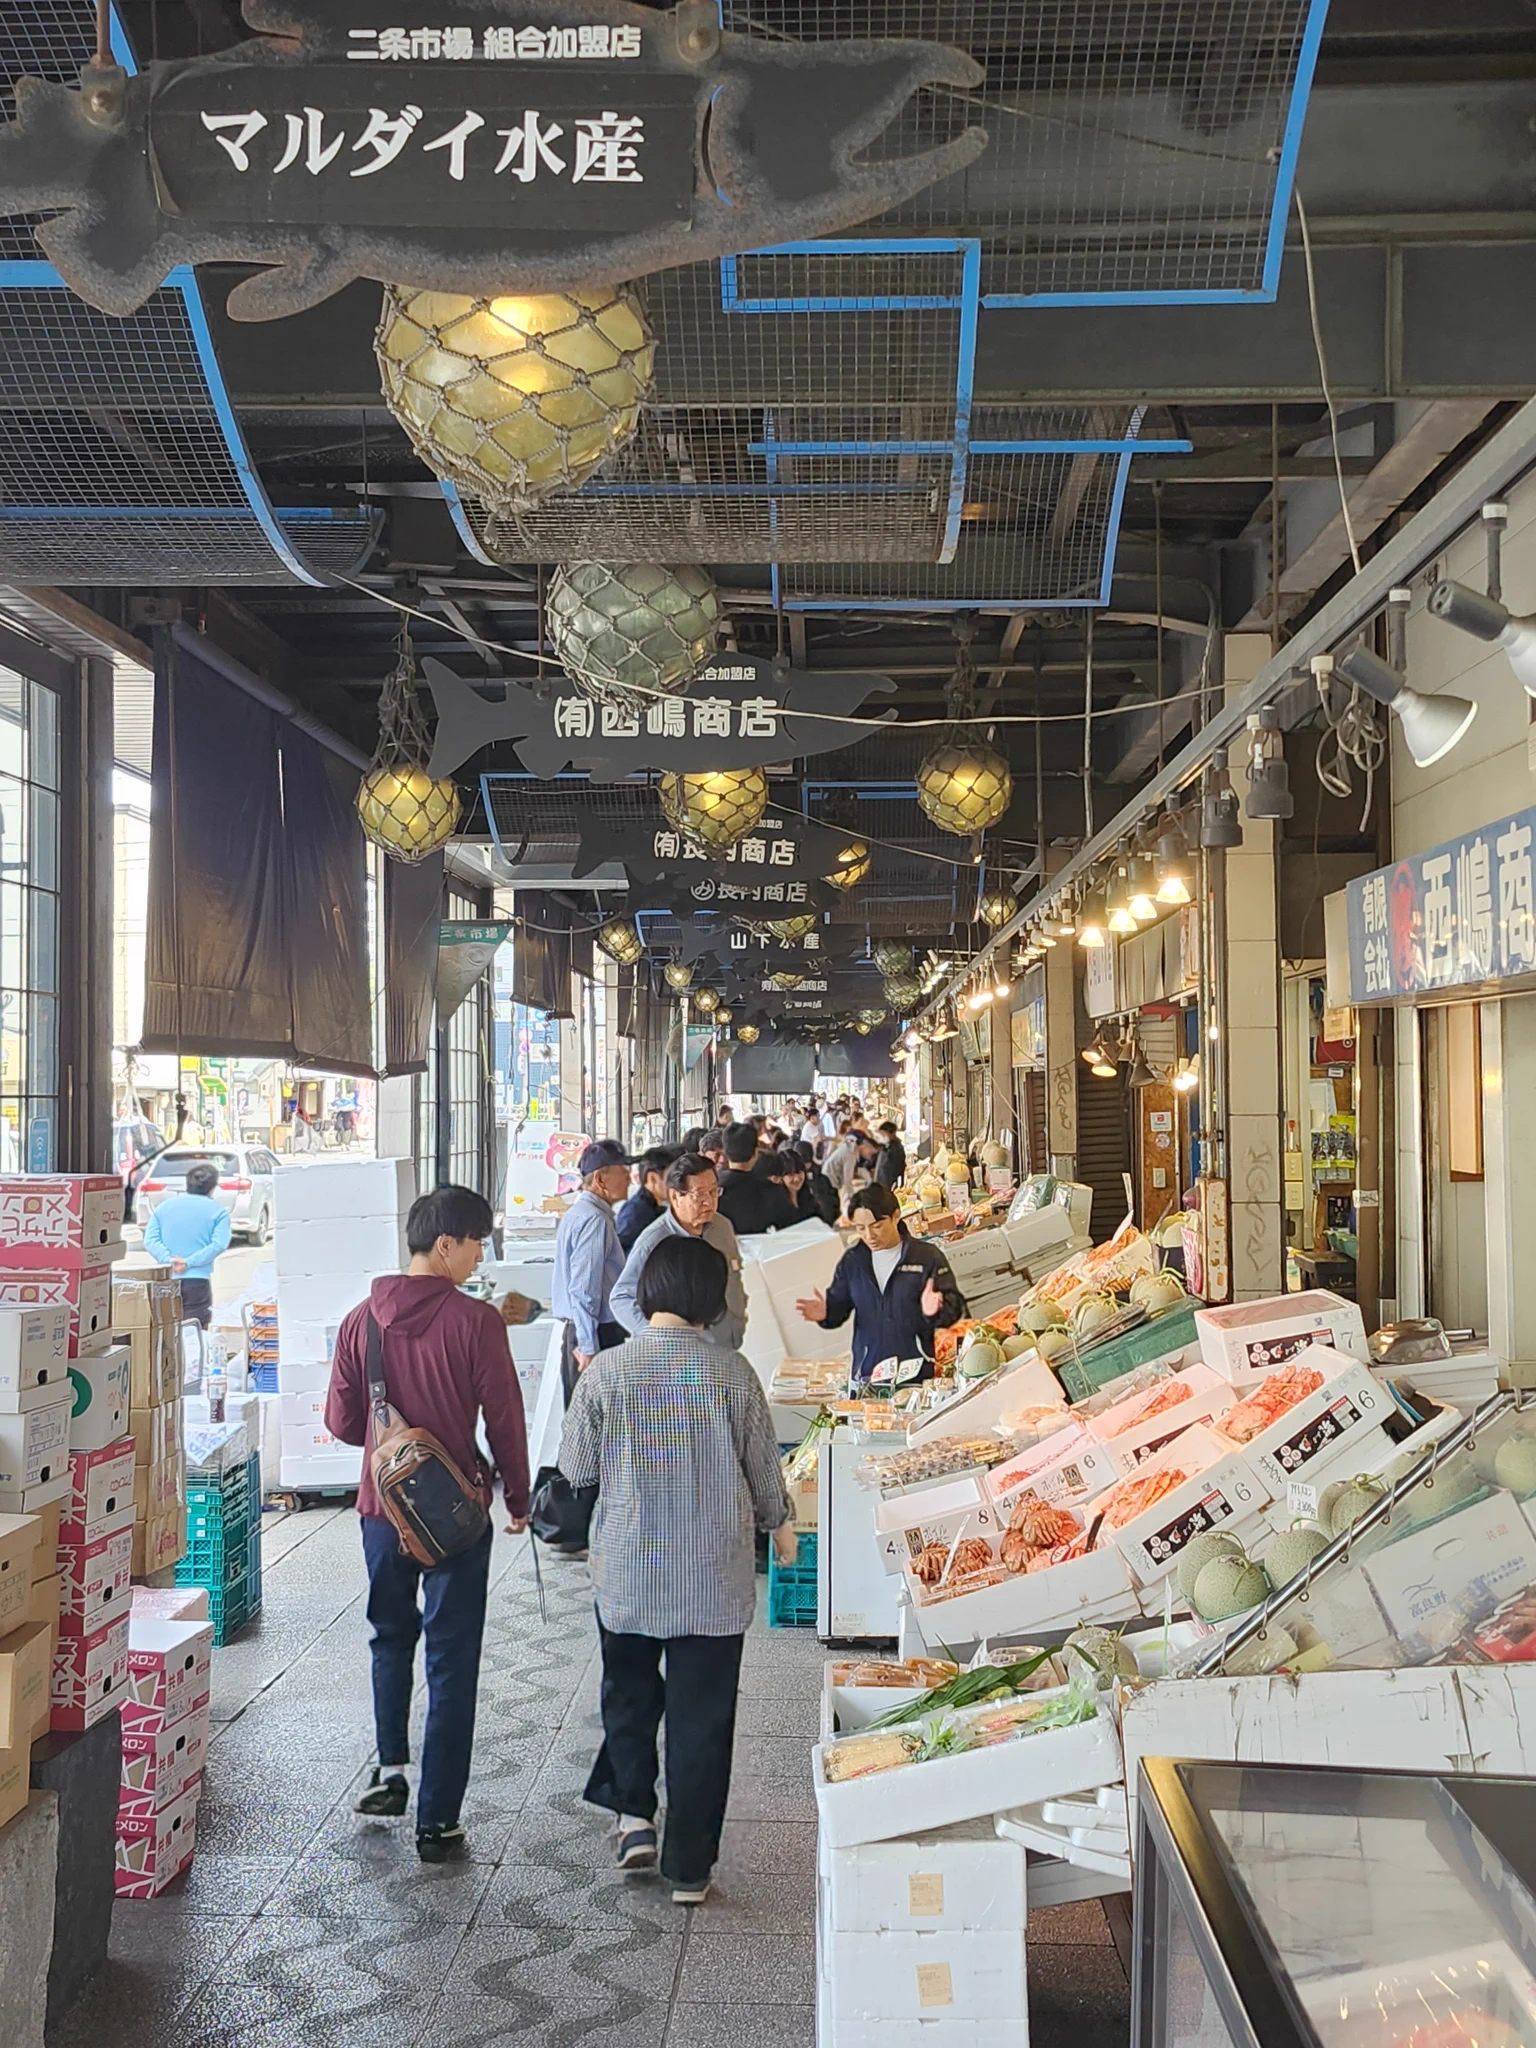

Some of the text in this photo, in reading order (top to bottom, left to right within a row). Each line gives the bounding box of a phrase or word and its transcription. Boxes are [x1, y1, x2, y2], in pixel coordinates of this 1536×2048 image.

[347, 26, 642, 60] 二条市場 組合加盟店
[200, 104, 646, 185] マルダイ水産
[2, 1195, 65, 1217] メロン
[1, 1216, 64, 1237] アサヒ
[1340, 1330, 1354, 1350] 7
[1357, 1389, 1376, 1410] 6
[1083, 1453, 1096, 1469] 6
[1233, 1482, 1252, 1502] 6
[977, 1509, 990, 1525] 8
[128, 1654, 158, 1667] メロン
